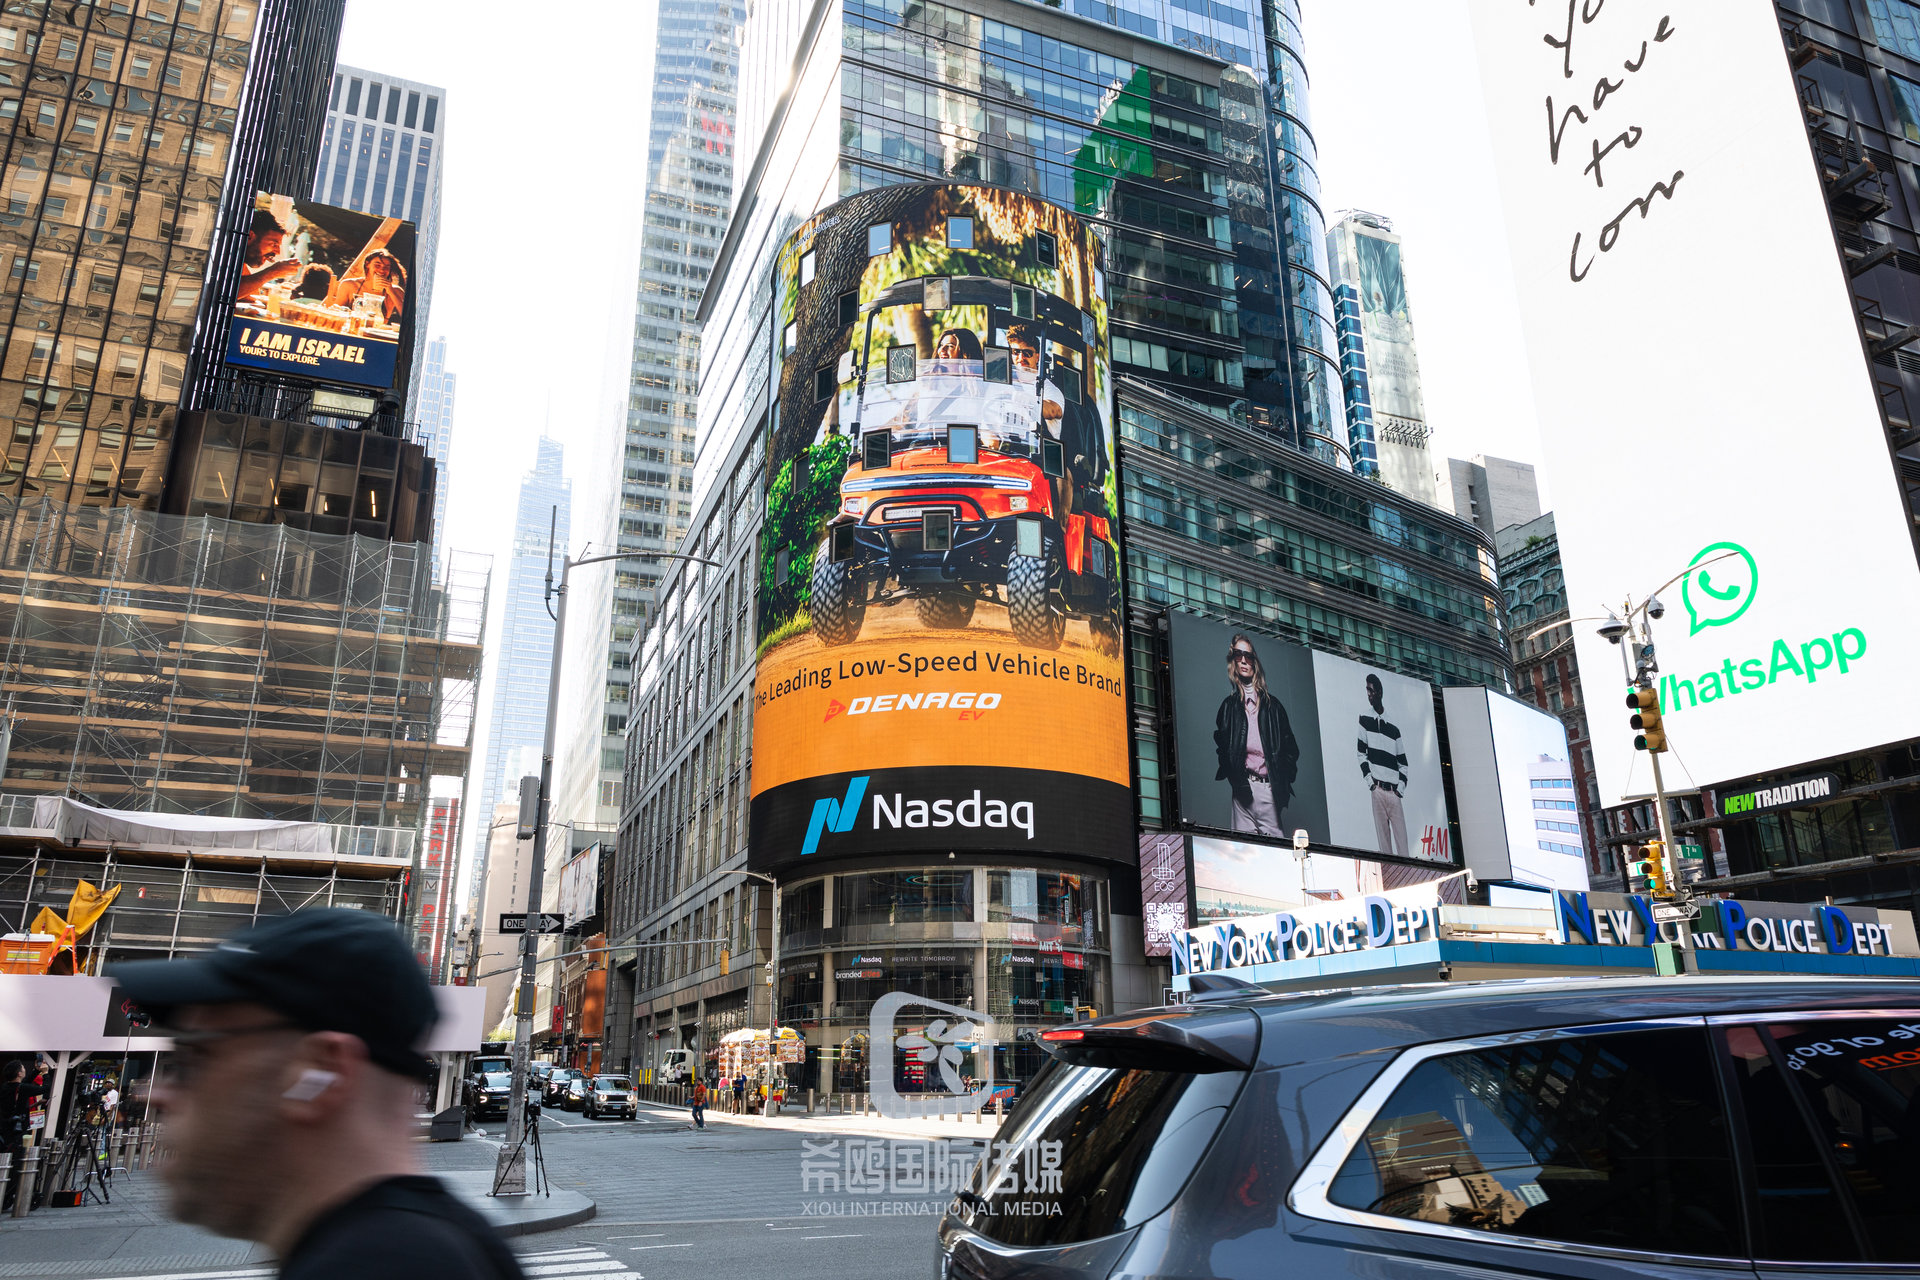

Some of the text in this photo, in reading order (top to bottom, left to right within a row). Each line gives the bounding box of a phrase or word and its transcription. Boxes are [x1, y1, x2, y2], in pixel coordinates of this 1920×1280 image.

[1546, 15, 1675, 165] have
[1583, 125, 1643, 188] to
[240, 328, 365, 364] I AM ISRAEL
[240, 344, 320, 366] YOURS TO EXPLORE.
[769, 667, 832, 701] Leading
[838, 650, 977, 680] Low-Speed
[985, 652, 1070, 681] Vehicle
[1076, 664, 1122, 698] Brand
[847, 692, 1002, 716] DENAGO
[958, 710, 985, 721] EV
[872, 789, 1034, 841] Nasdaq
[1420, 824, 1448, 859] H&M
[506, 919, 552, 929] ONE AY
[1558, 891, 1894, 956] NEW YO POLICE DEPT
[1656, 905, 1694, 917] ONE WAY
[1170, 895, 1442, 975] NEW YORK POLICE DEPT
[860, 956, 882, 964] Nasdaq
